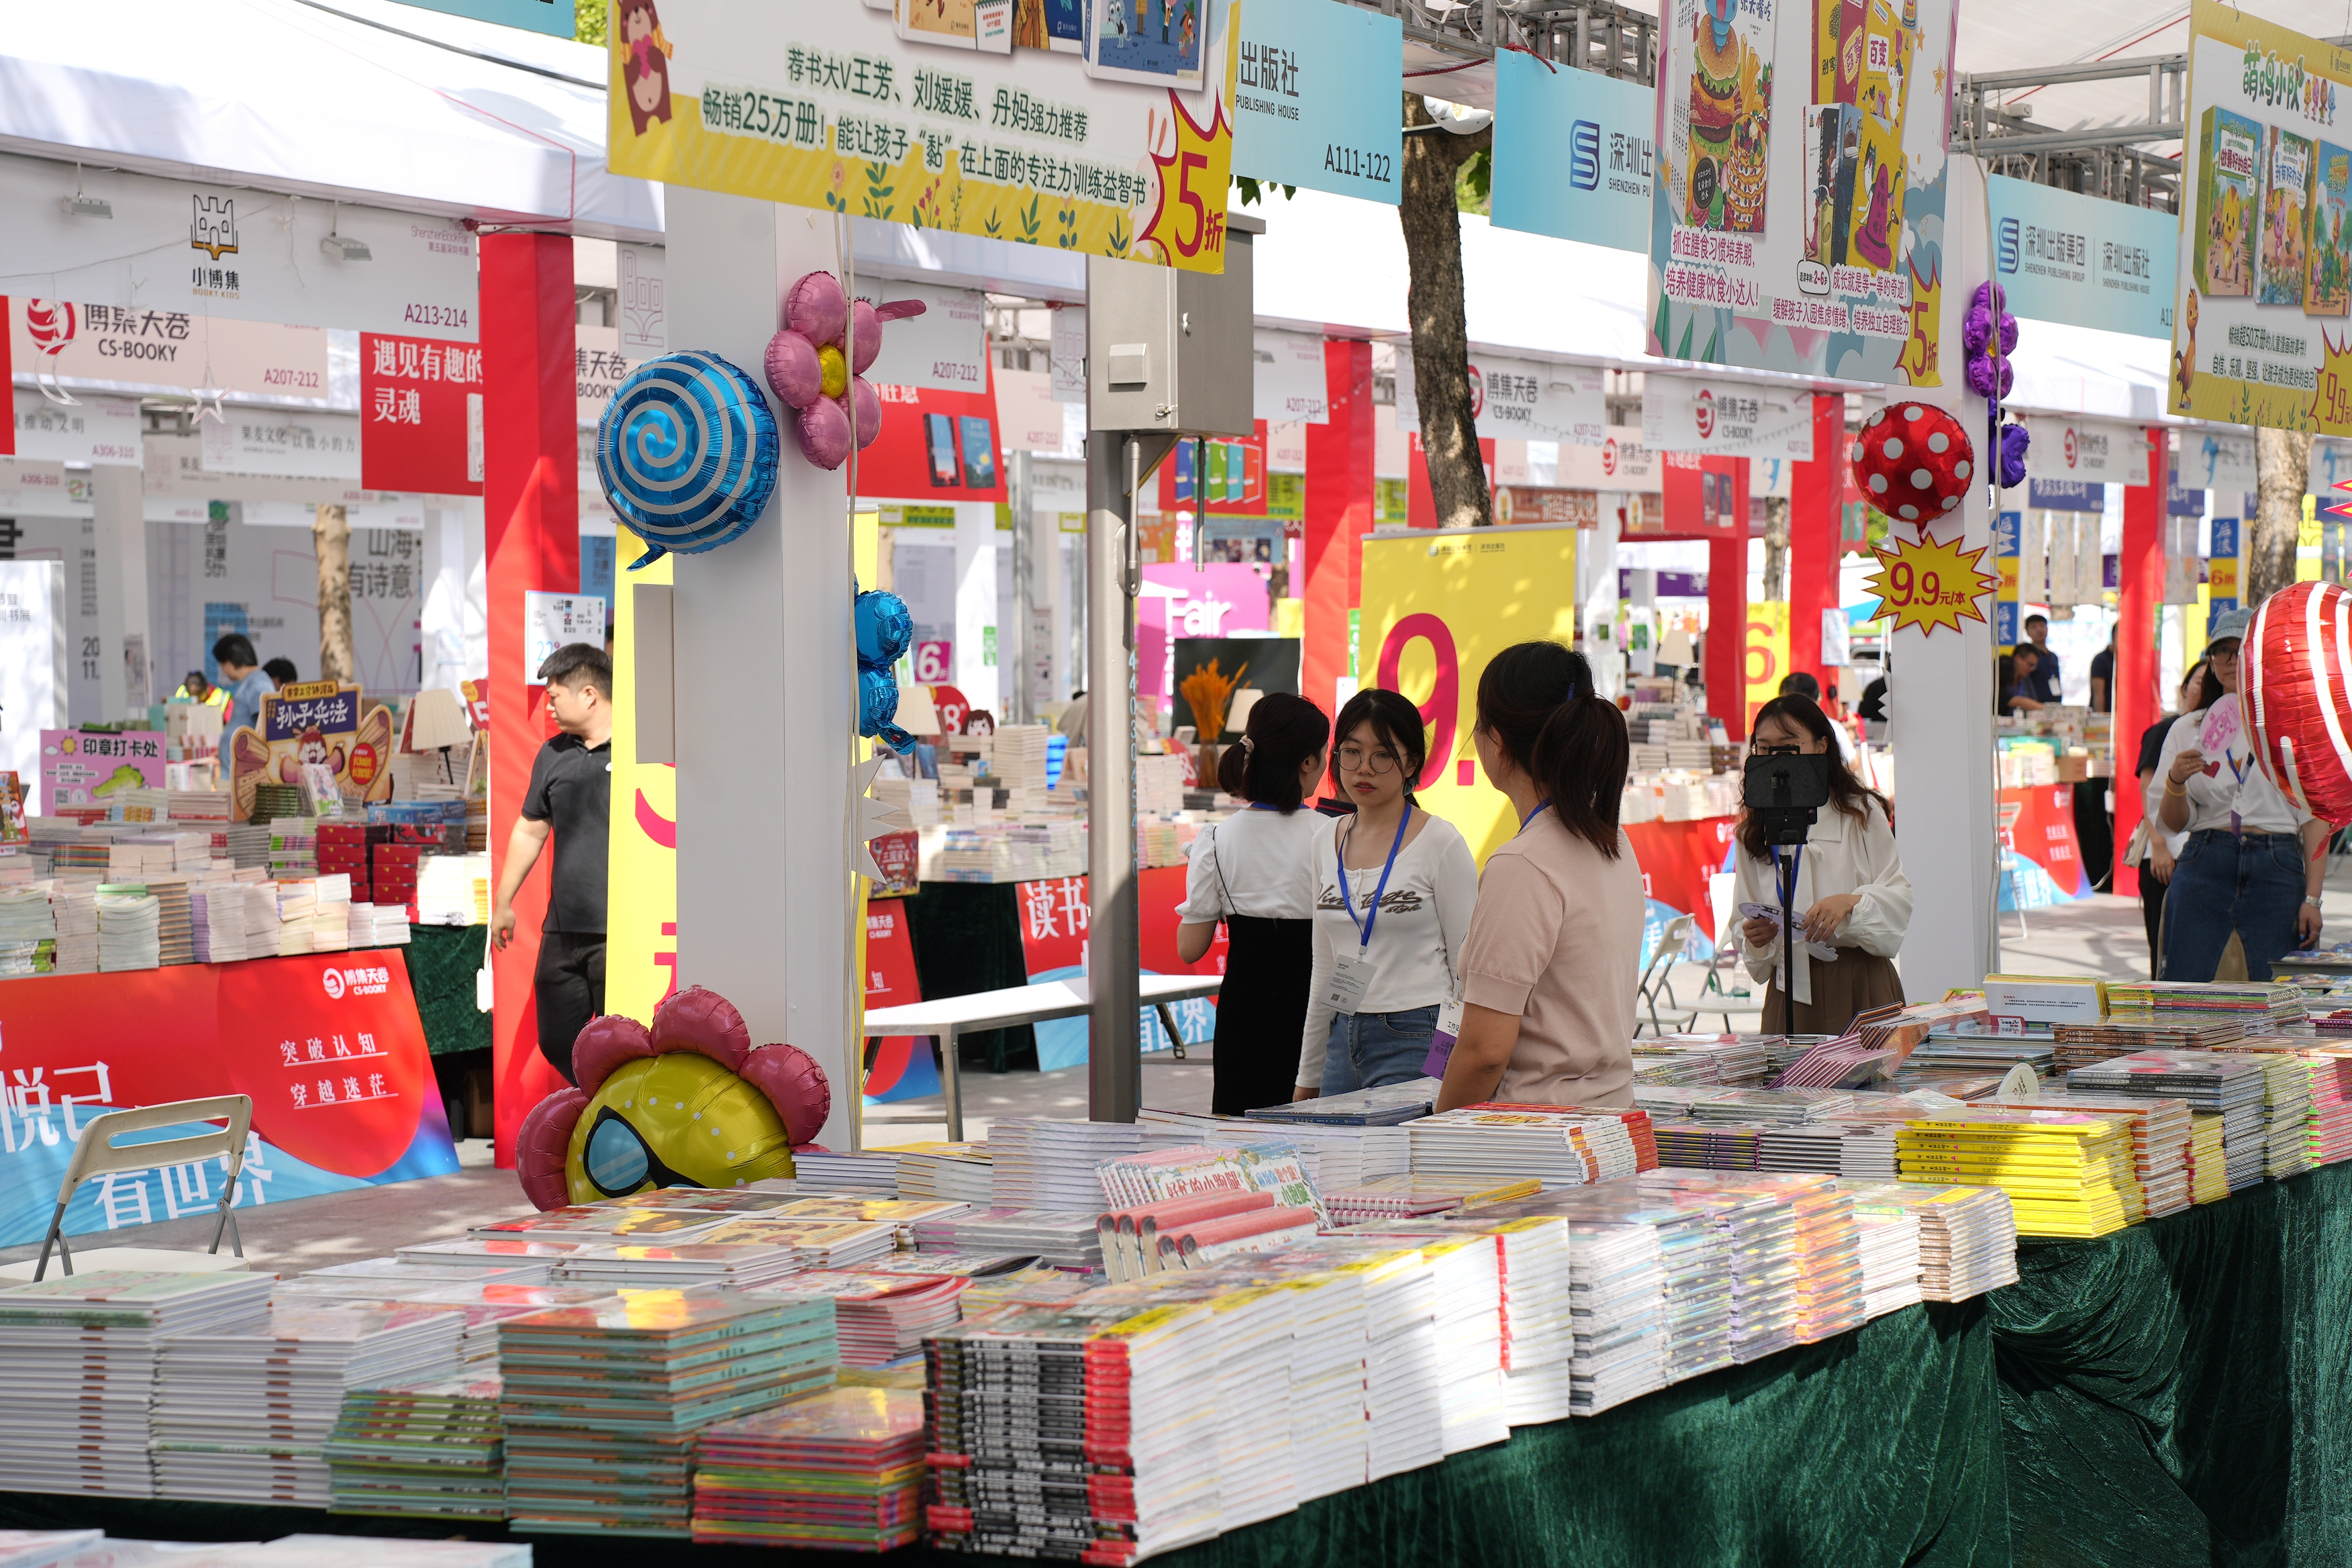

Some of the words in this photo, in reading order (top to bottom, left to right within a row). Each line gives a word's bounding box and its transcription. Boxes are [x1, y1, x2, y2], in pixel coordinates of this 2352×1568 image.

[1870, 40, 1888, 67] 百变
[1236, 95, 1275, 116] PUBLISHING
[1277, 103, 1300, 121] HOUSE
[1324, 143, 1391, 183] A111-122
[1608, 177, 1640, 197] SHENZHEN
[2024, 225, 2085, 266] 深圳出版集团
[2024, 262, 2046, 276] SHENZHEN
[2071, 271, 2085, 283] GROUP
[2102, 242, 2150, 279] 深圳出版社
[192, 266, 240, 292] 小博集
[221, 289, 240, 299] KIDS
[404, 303, 469, 329] A213-214
[98, 338, 177, 362] CS-BOOKY
[264, 369, 320, 388] A207-212
[932, 361, 979, 382] A207-212
[1486, 371, 1538, 403] 博集天卷
[373, 386, 422, 426] 灵魂
[1890, 561, 1965, 607] 9.9元/本
[1166, 588, 1232, 638] Fair
[276, 697, 350, 730] 孙子兵法
[83, 737, 158, 758] 印章打卡处
[1384, 903, 1422, 914] style
[344, 966, 389, 987] 博集天卷
[353, 983, 387, 996] CS-BOOKY
[280, 1032, 377, 1064] 突破认知
[290, 1073, 387, 1108] 穿越迷茫
[1281, 1182, 1312, 1204] 小跑腿
